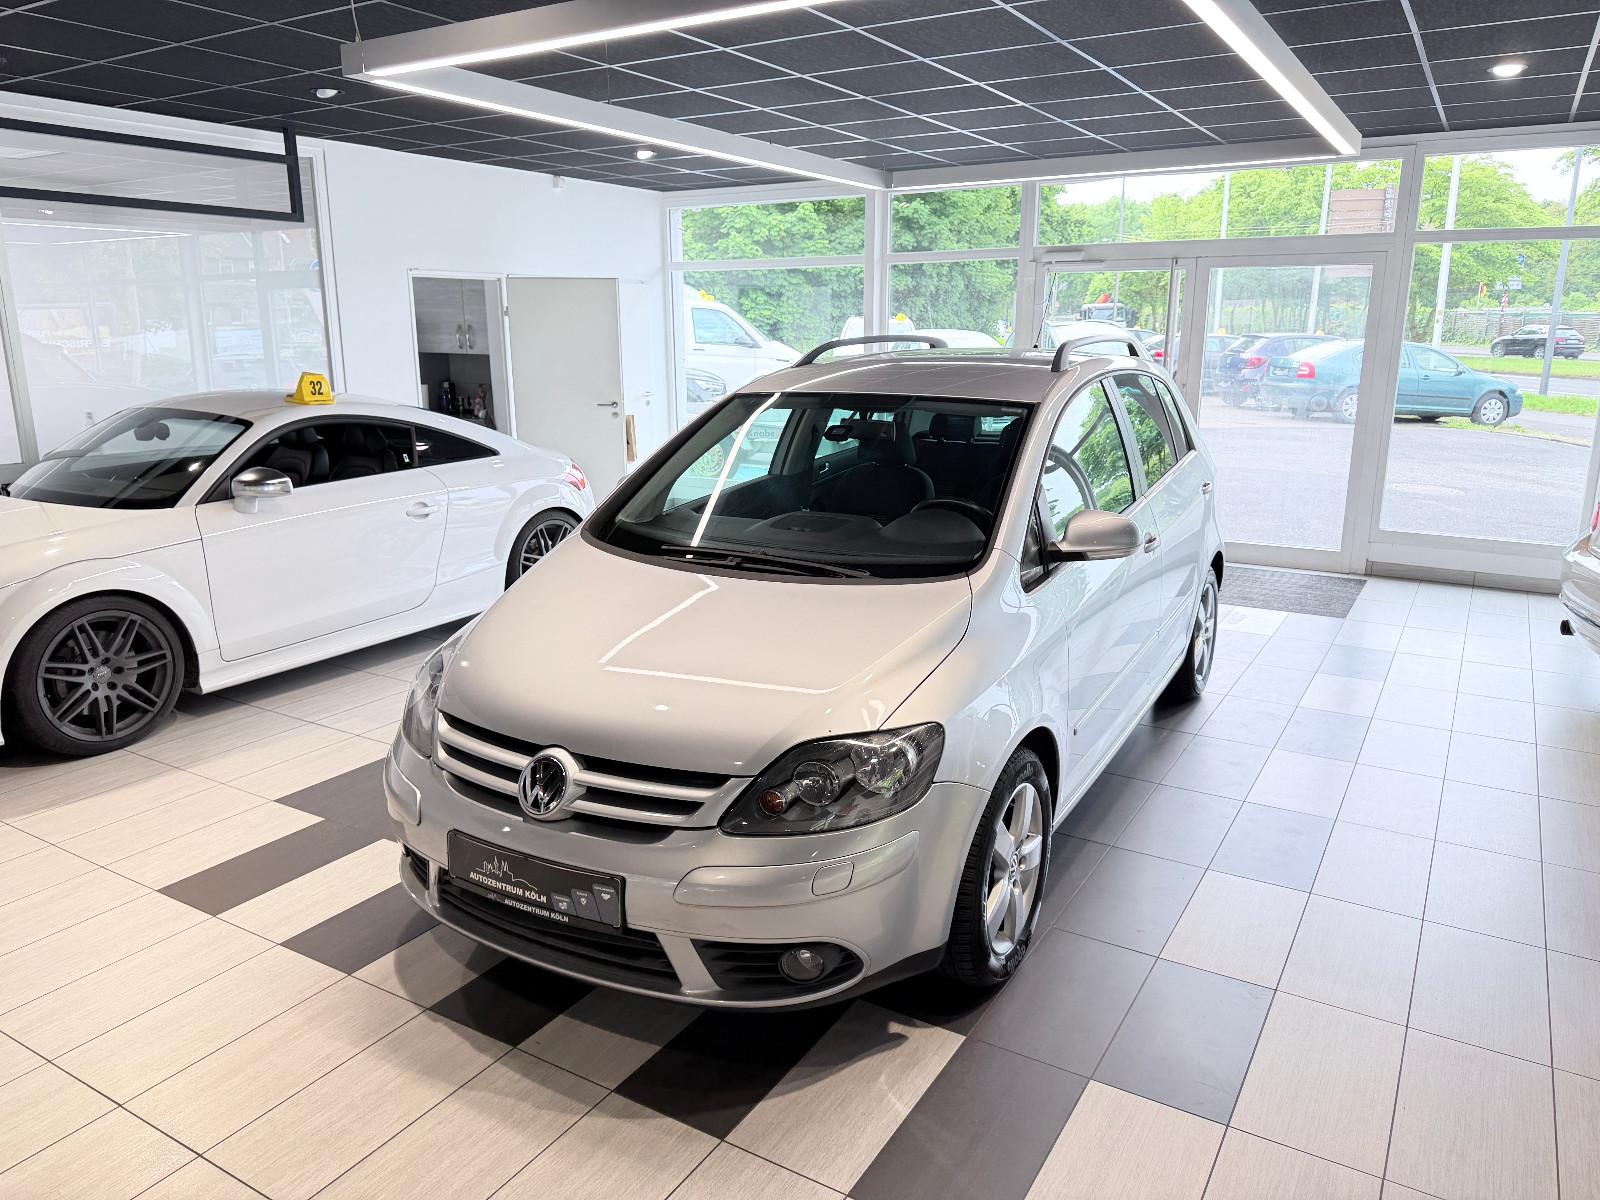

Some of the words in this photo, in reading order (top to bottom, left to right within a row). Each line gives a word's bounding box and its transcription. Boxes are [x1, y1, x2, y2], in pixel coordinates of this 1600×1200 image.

[309, 380, 324, 396] 32
[469, 871, 523, 897] AUTOZENTRUM
[524, 889, 547, 904] KÖLN
[504, 898, 550, 918] AUTOZENTRUM
[550, 911, 569, 923] KÖLN
